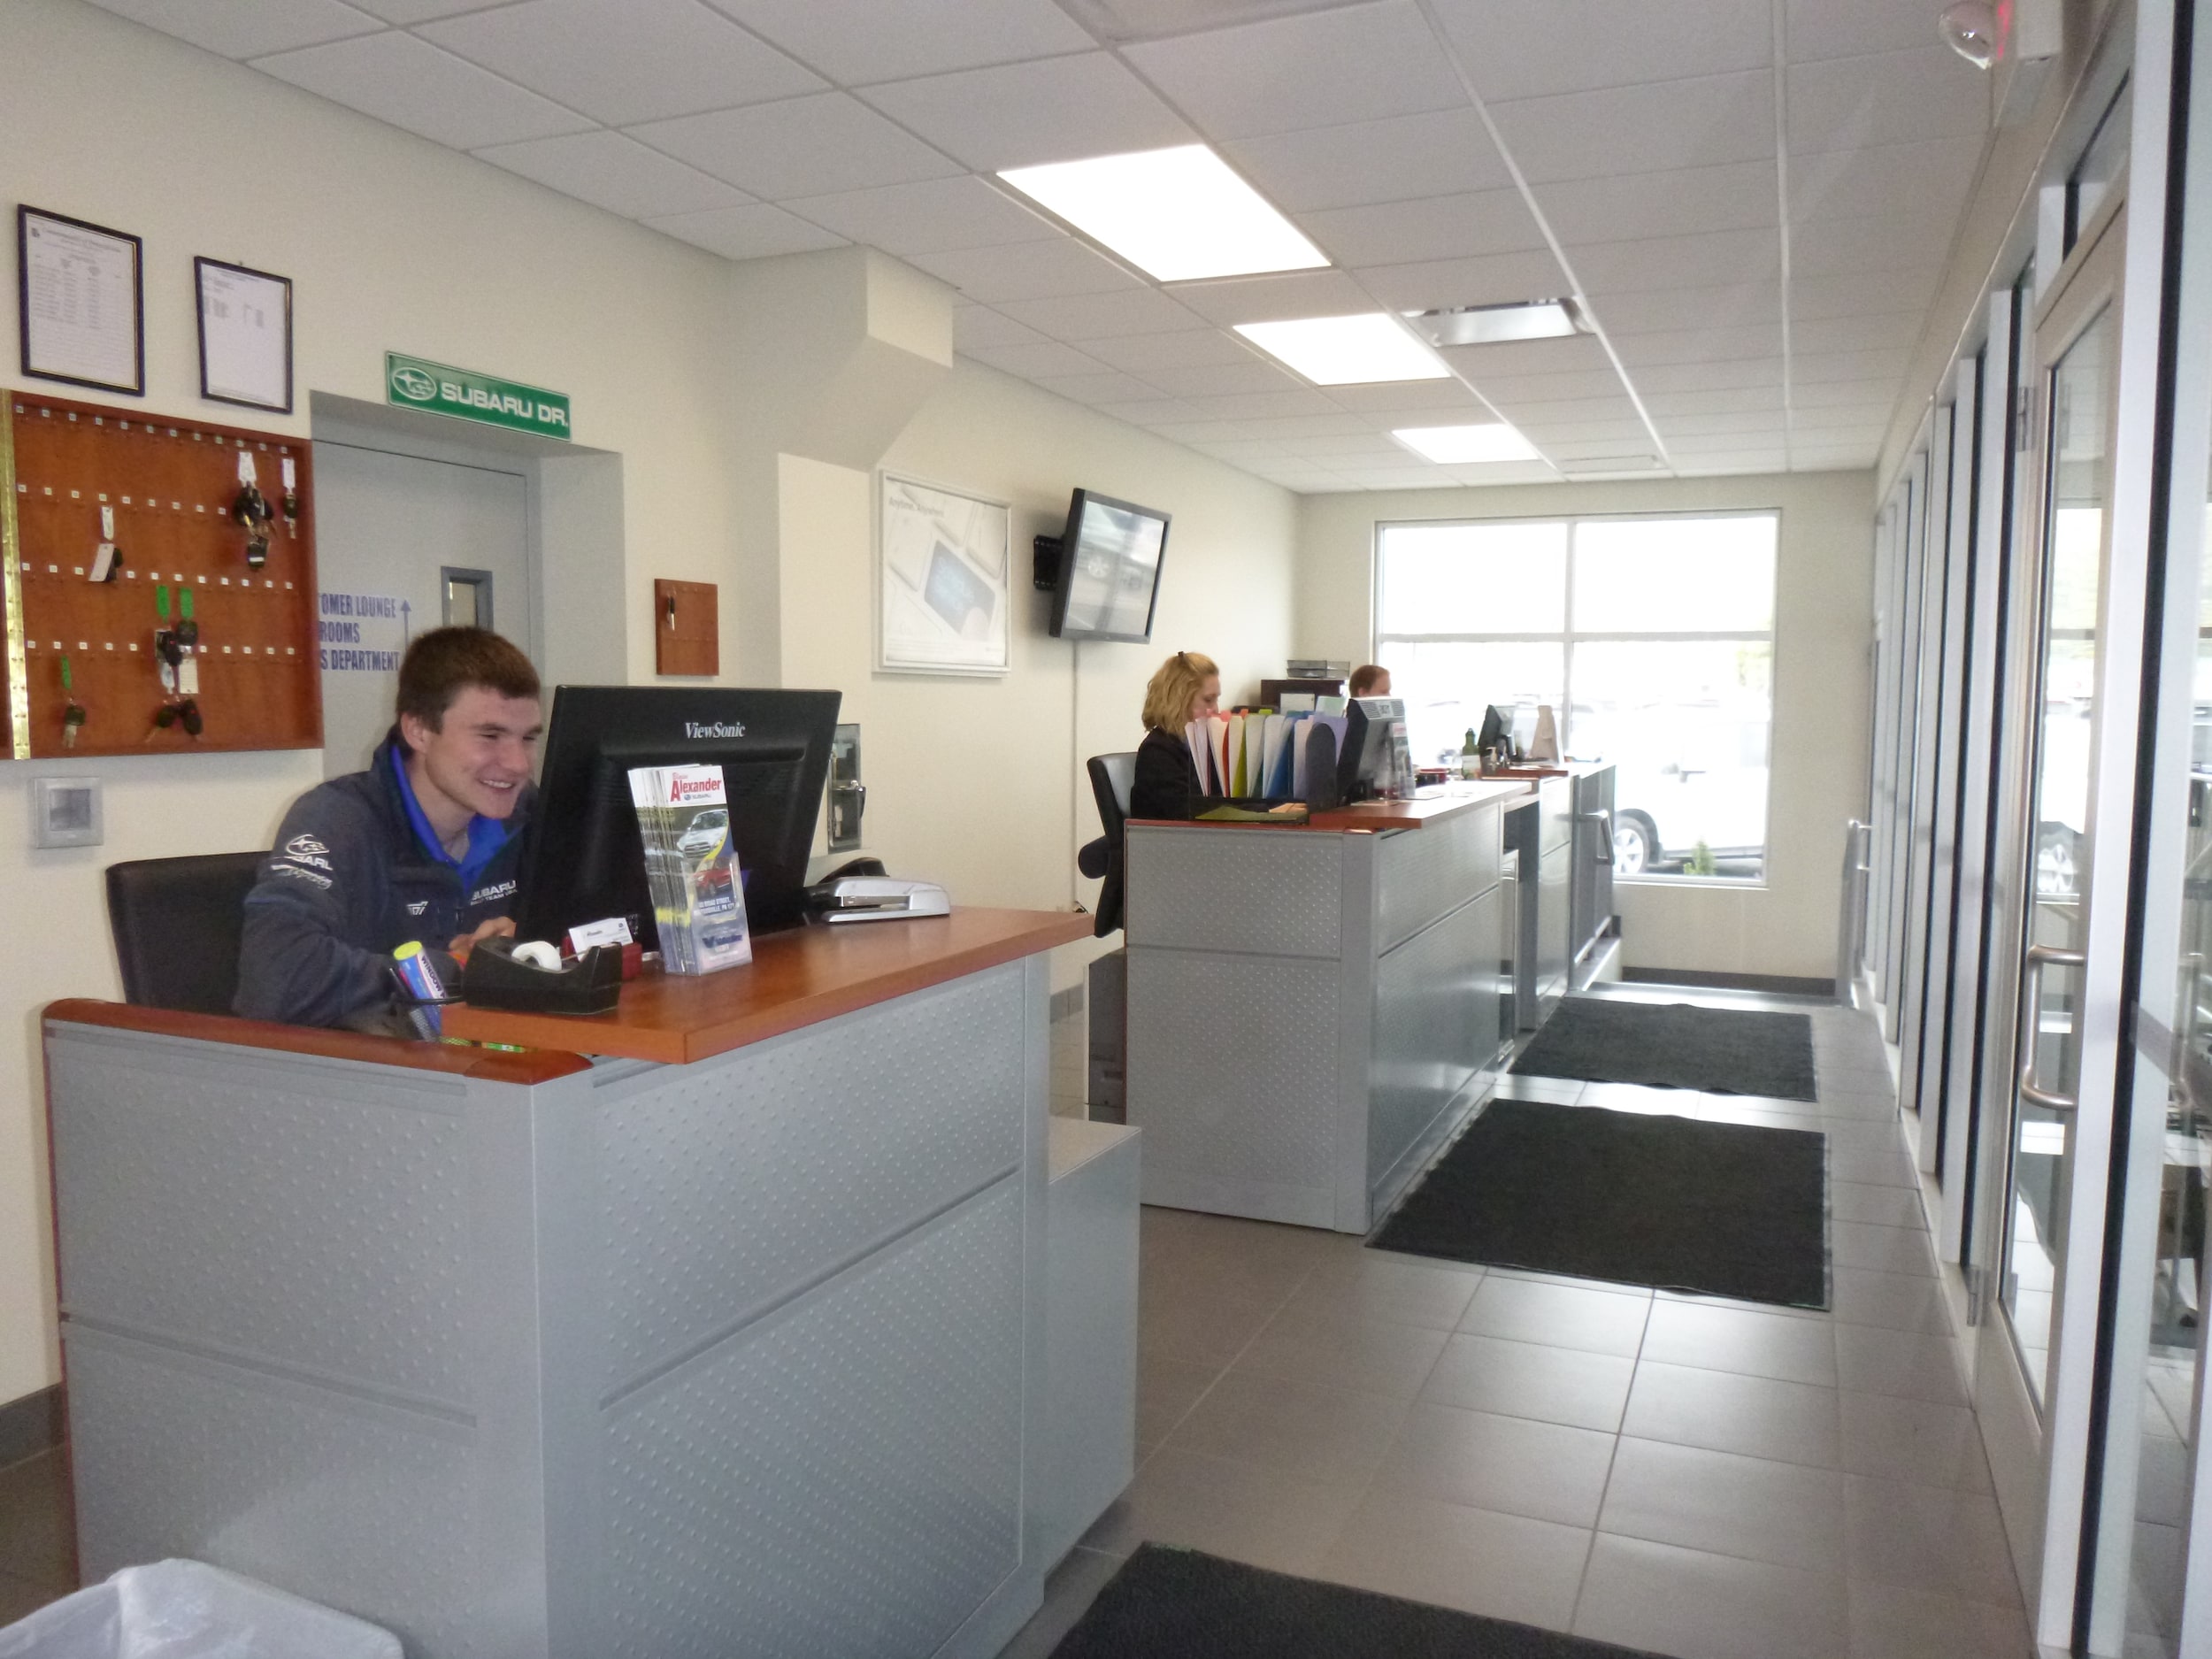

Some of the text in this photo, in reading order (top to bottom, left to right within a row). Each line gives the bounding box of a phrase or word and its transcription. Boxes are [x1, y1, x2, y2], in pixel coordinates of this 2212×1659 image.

[441, 382, 568, 426] SUBARU DR.
[356, 595, 396, 618] LOUNGE
[331, 649, 400, 672] DEPARTMENT
[685, 720, 746, 740] ViewSonic
[670, 777, 722, 803] Alexander
[472, 879, 517, 901] SUBARU
[421, 955, 442, 992] WINDOW
